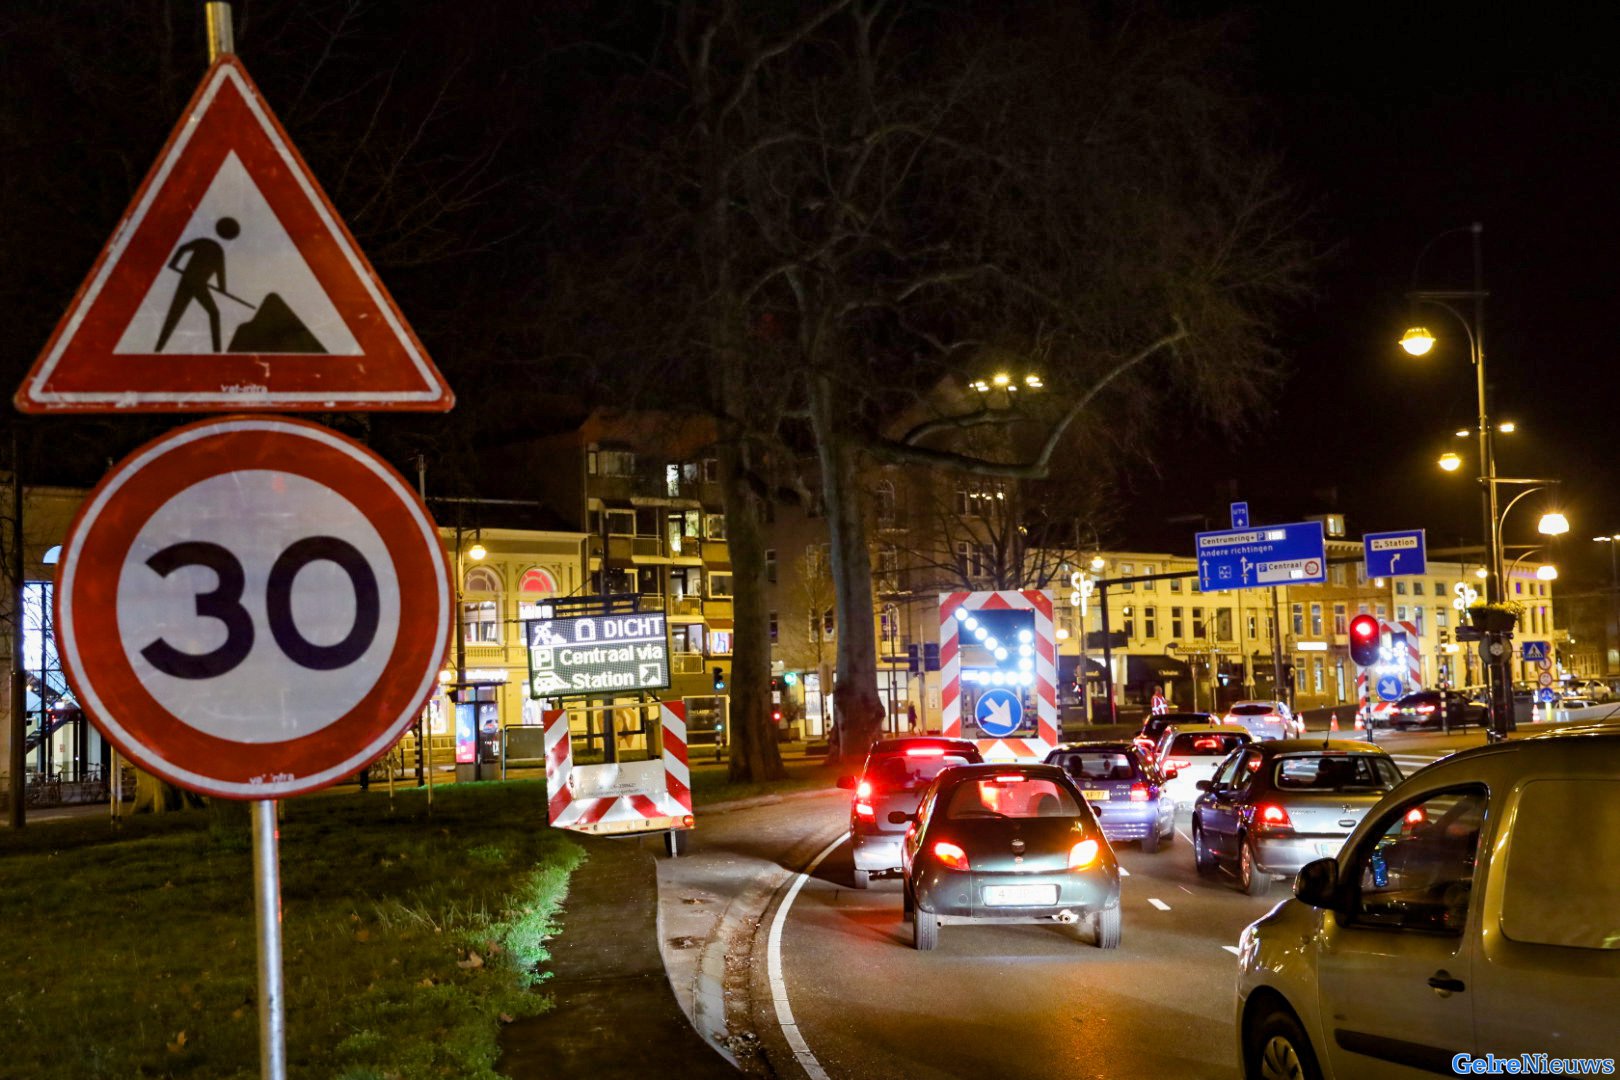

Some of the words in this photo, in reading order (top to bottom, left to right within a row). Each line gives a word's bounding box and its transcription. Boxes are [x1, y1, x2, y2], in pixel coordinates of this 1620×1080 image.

[1231, 545, 1273, 556] richtingen
[1384, 539, 1415, 547] Station
[1268, 561, 1302, 570] Centraal
[140, 535, 380, 680] 30
[603, 616, 664, 638] DICHT
[560, 645, 635, 666] Centraal
[636, 643, 663, 660] via
[572, 670, 635, 690] Station
